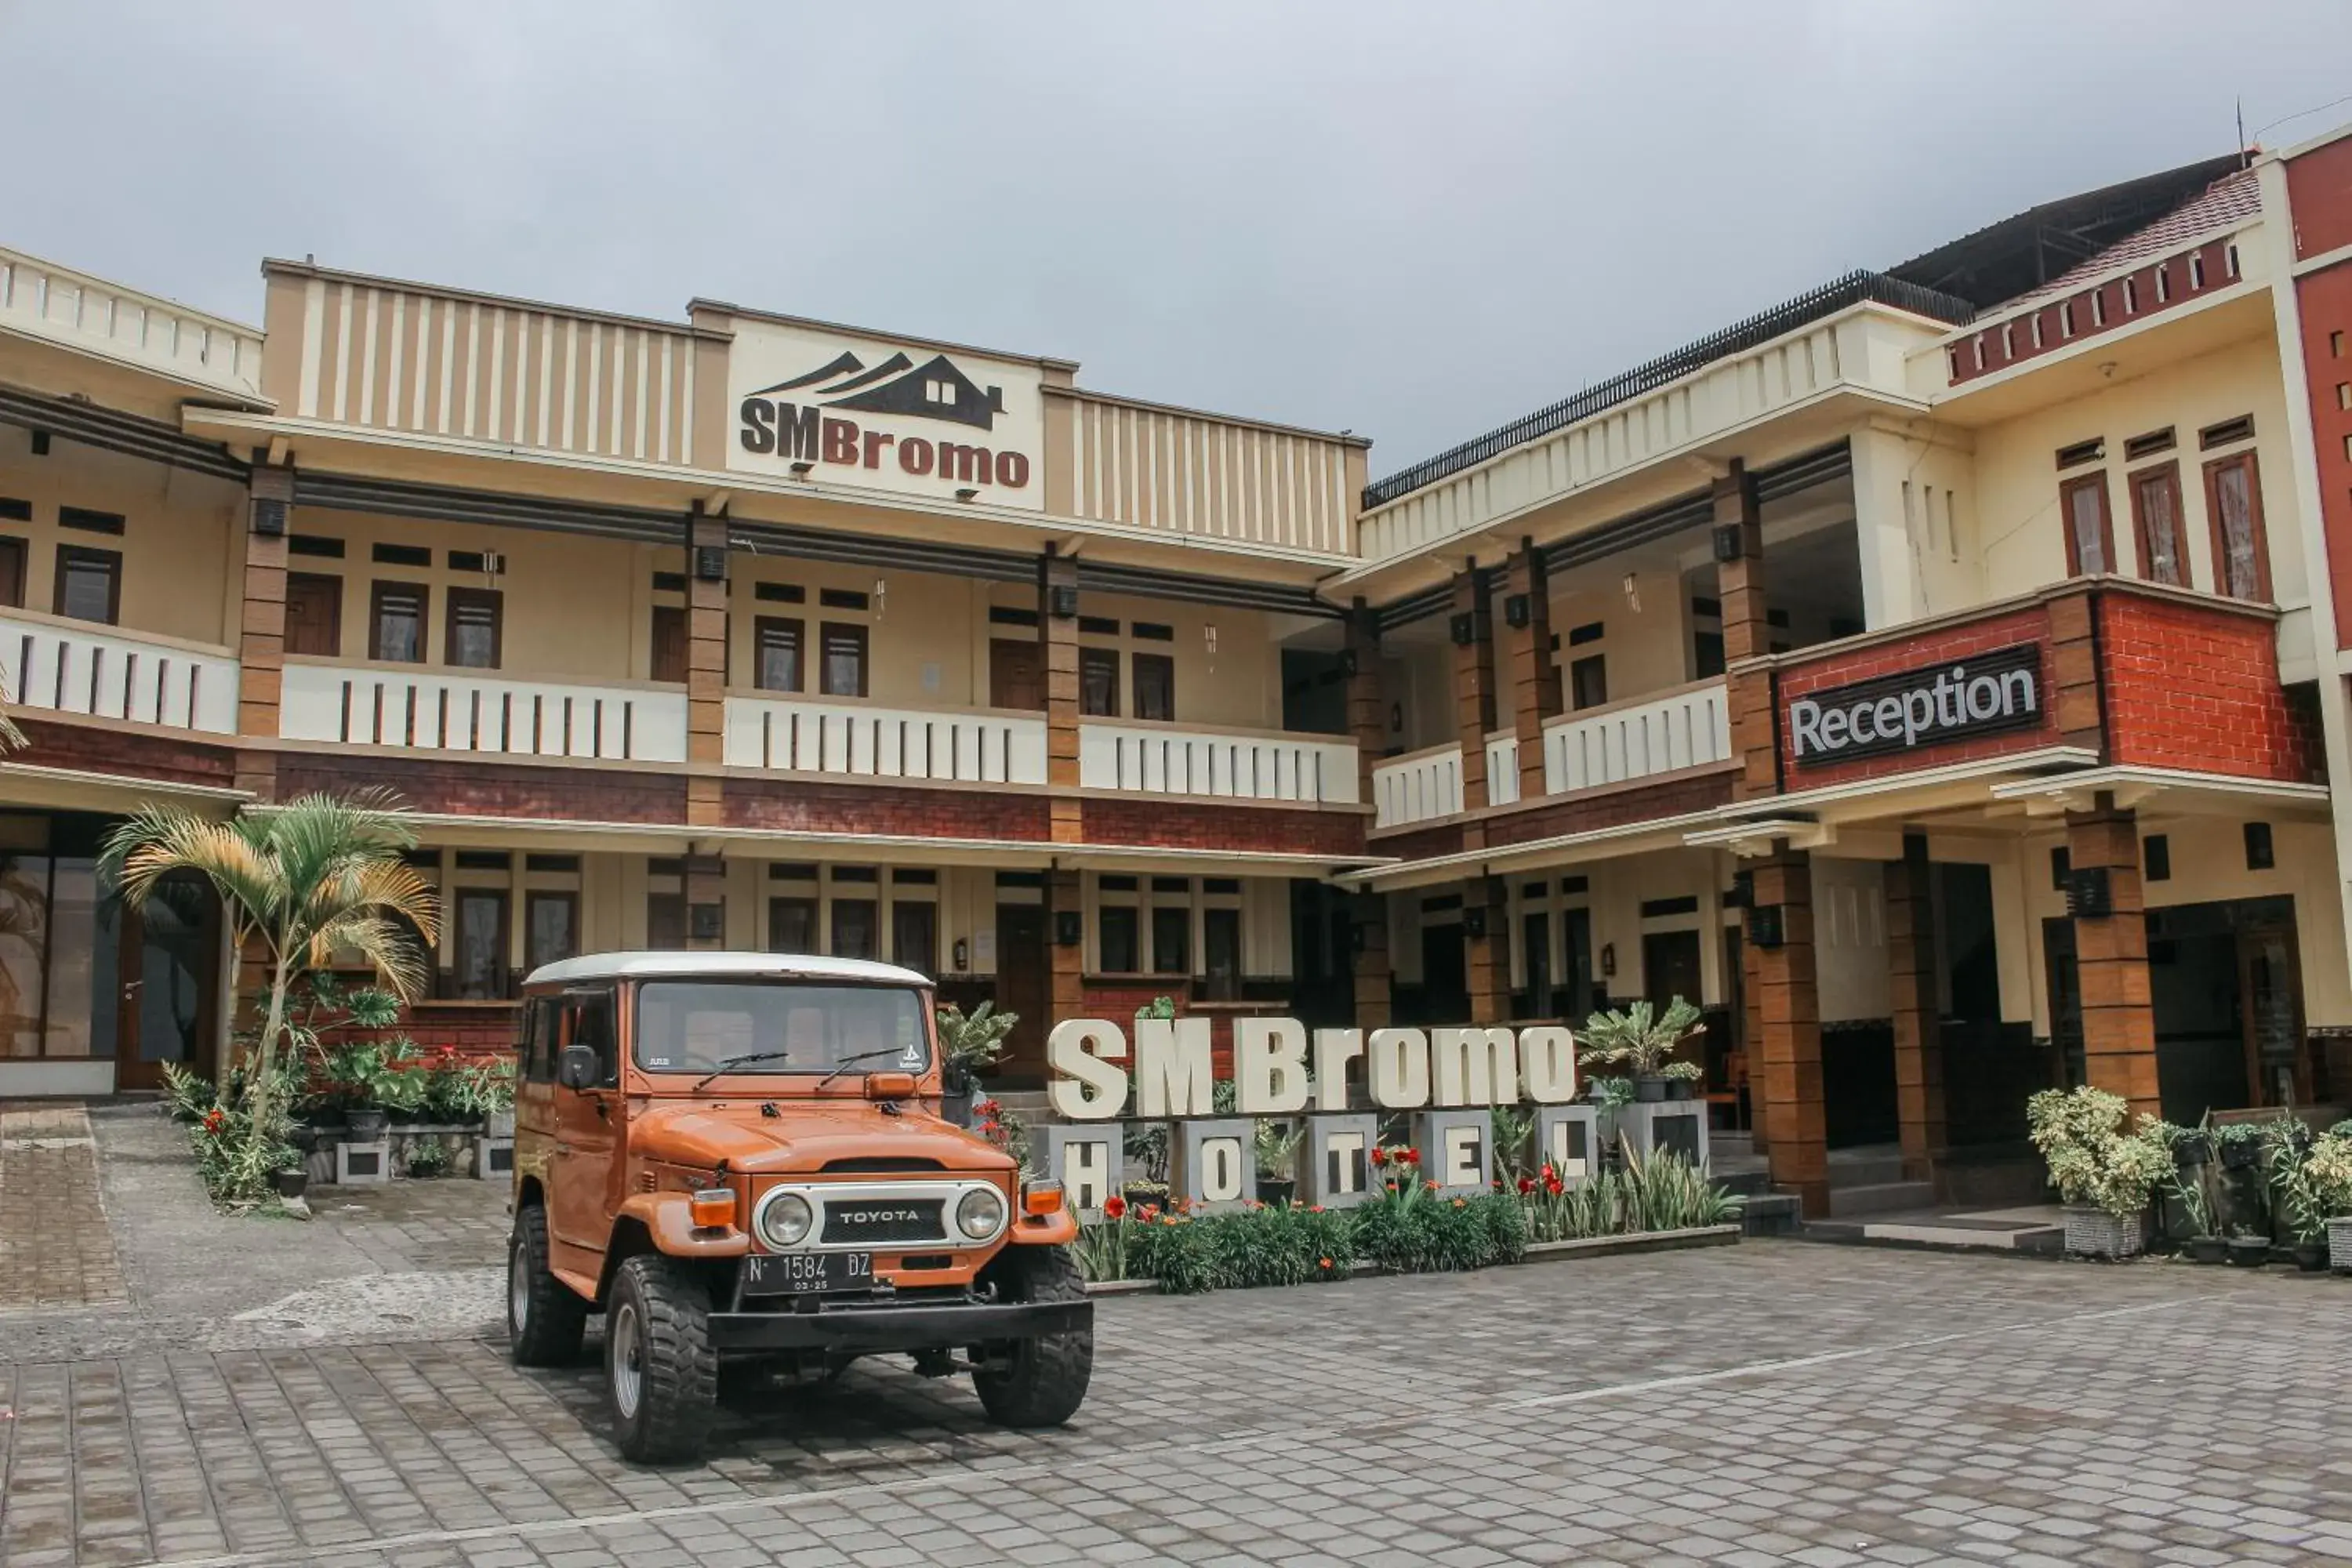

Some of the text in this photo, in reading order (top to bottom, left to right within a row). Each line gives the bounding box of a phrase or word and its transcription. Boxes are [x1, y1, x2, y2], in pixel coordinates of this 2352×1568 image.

[1790, 666, 2036, 756] Reception
[1065, 1121, 1587, 1209] HOTEL
[840, 1210, 919, 1224] TOYOTA
[783, 1254, 827, 1280] 1584
[848, 1254, 871, 1276] DZ
